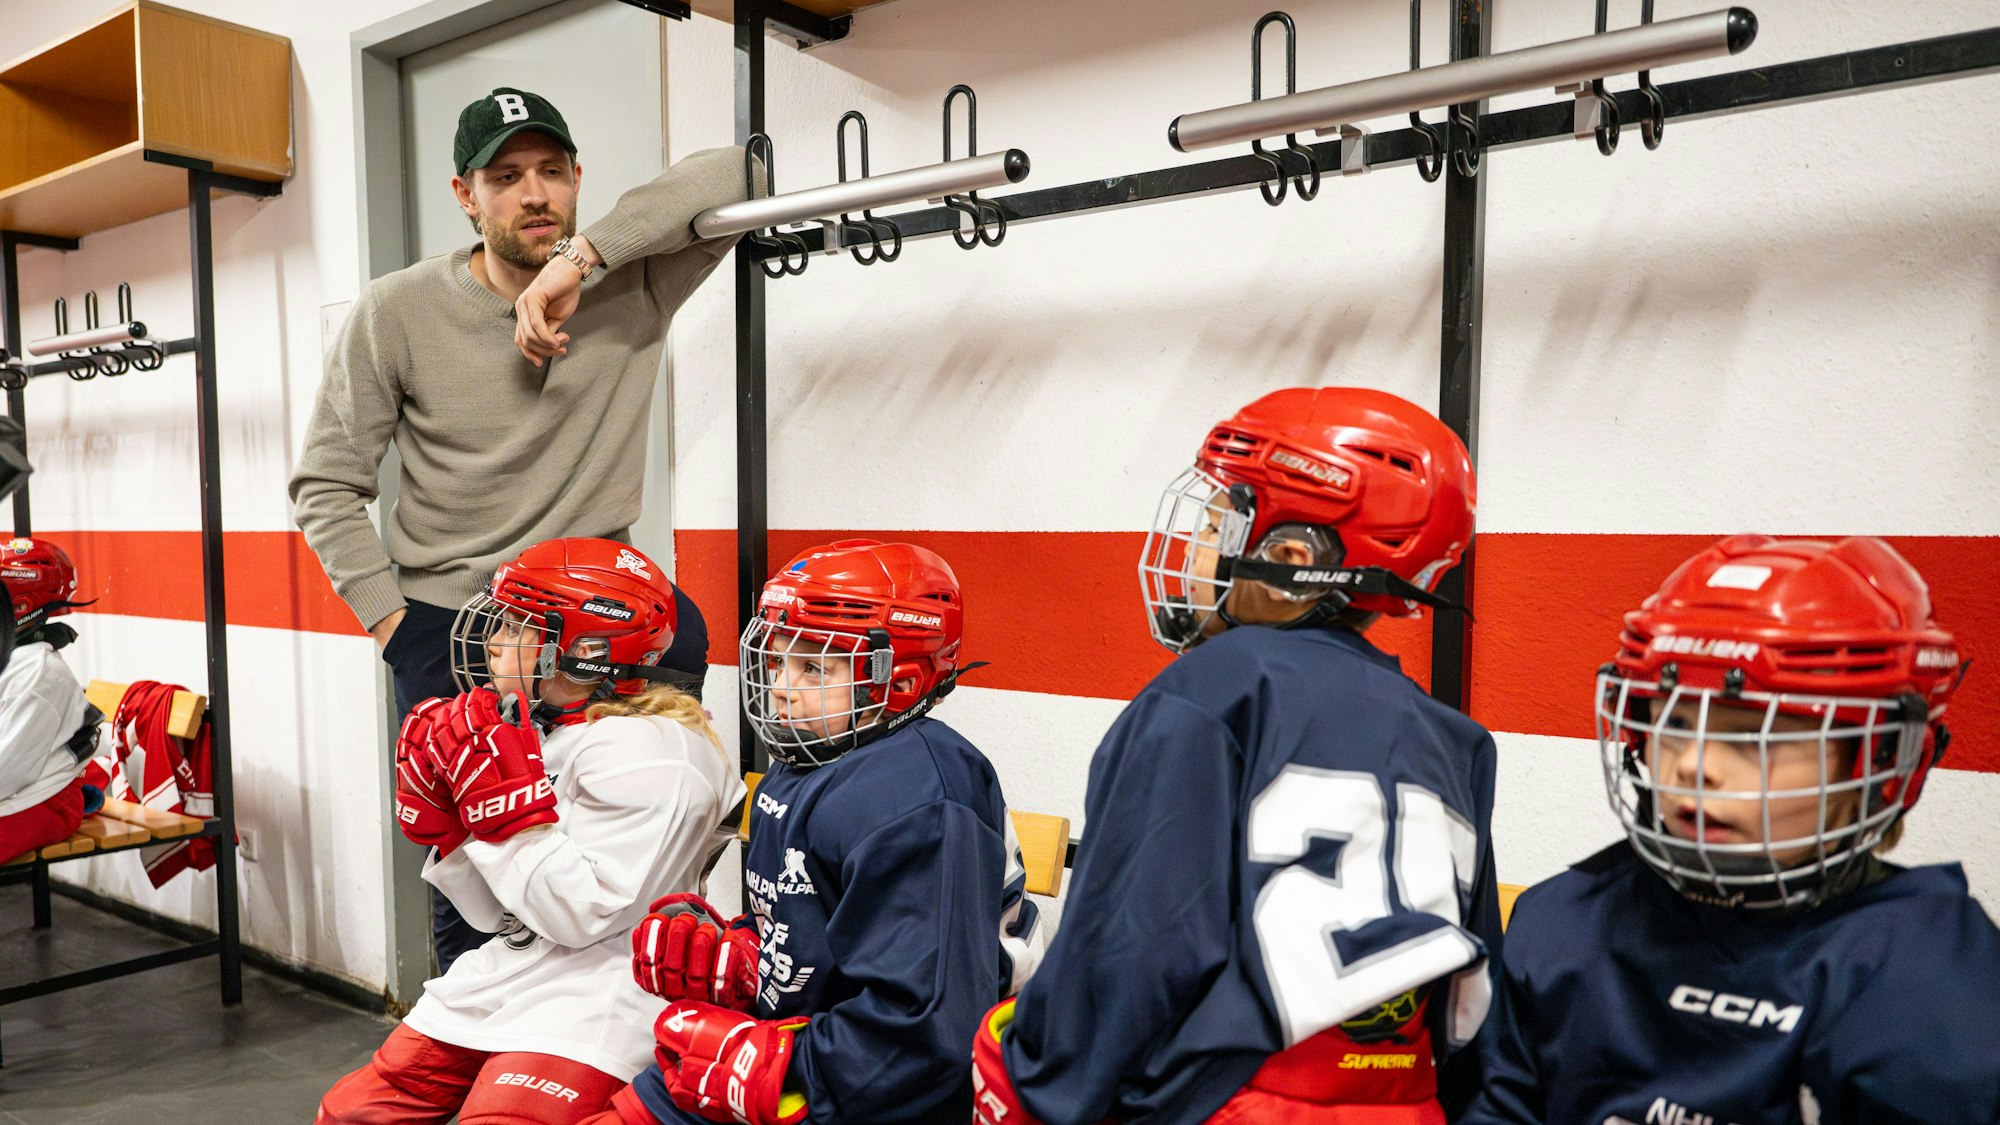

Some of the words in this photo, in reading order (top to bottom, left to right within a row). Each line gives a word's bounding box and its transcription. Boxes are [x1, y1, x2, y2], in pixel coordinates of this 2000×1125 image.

[494, 93, 530, 124] B
[1270, 451, 1350, 486] BAUER
[583, 602, 632, 620] BAUER
[890, 612, 942, 627] BAUER
[1652, 635, 1760, 661] BAUER
[888, 699, 927, 730] BAUER
[1668, 984, 1804, 1033] CCM
[1337, 1053, 1417, 1070] SUPREME
[494, 1072, 580, 1103] BAUER
